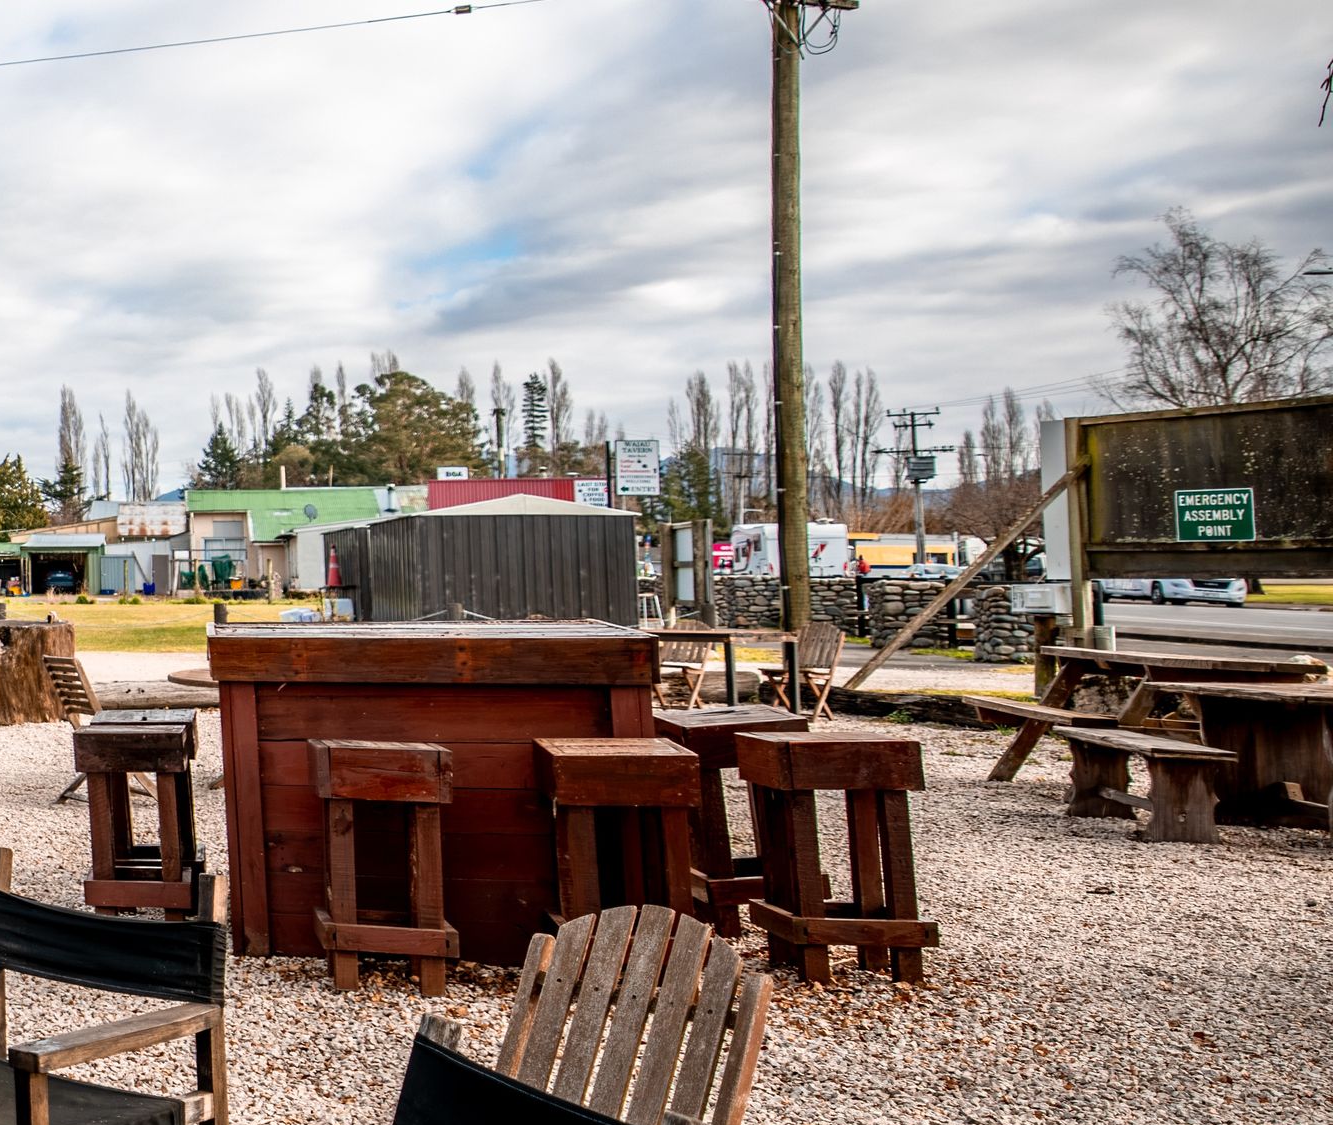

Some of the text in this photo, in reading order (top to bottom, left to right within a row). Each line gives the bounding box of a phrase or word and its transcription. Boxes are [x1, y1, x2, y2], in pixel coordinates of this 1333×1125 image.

[1178, 493, 1249, 506] EMERGENCY
[1184, 509, 1245, 521] ASSEMBLY
[1197, 525, 1232, 537] POINT
